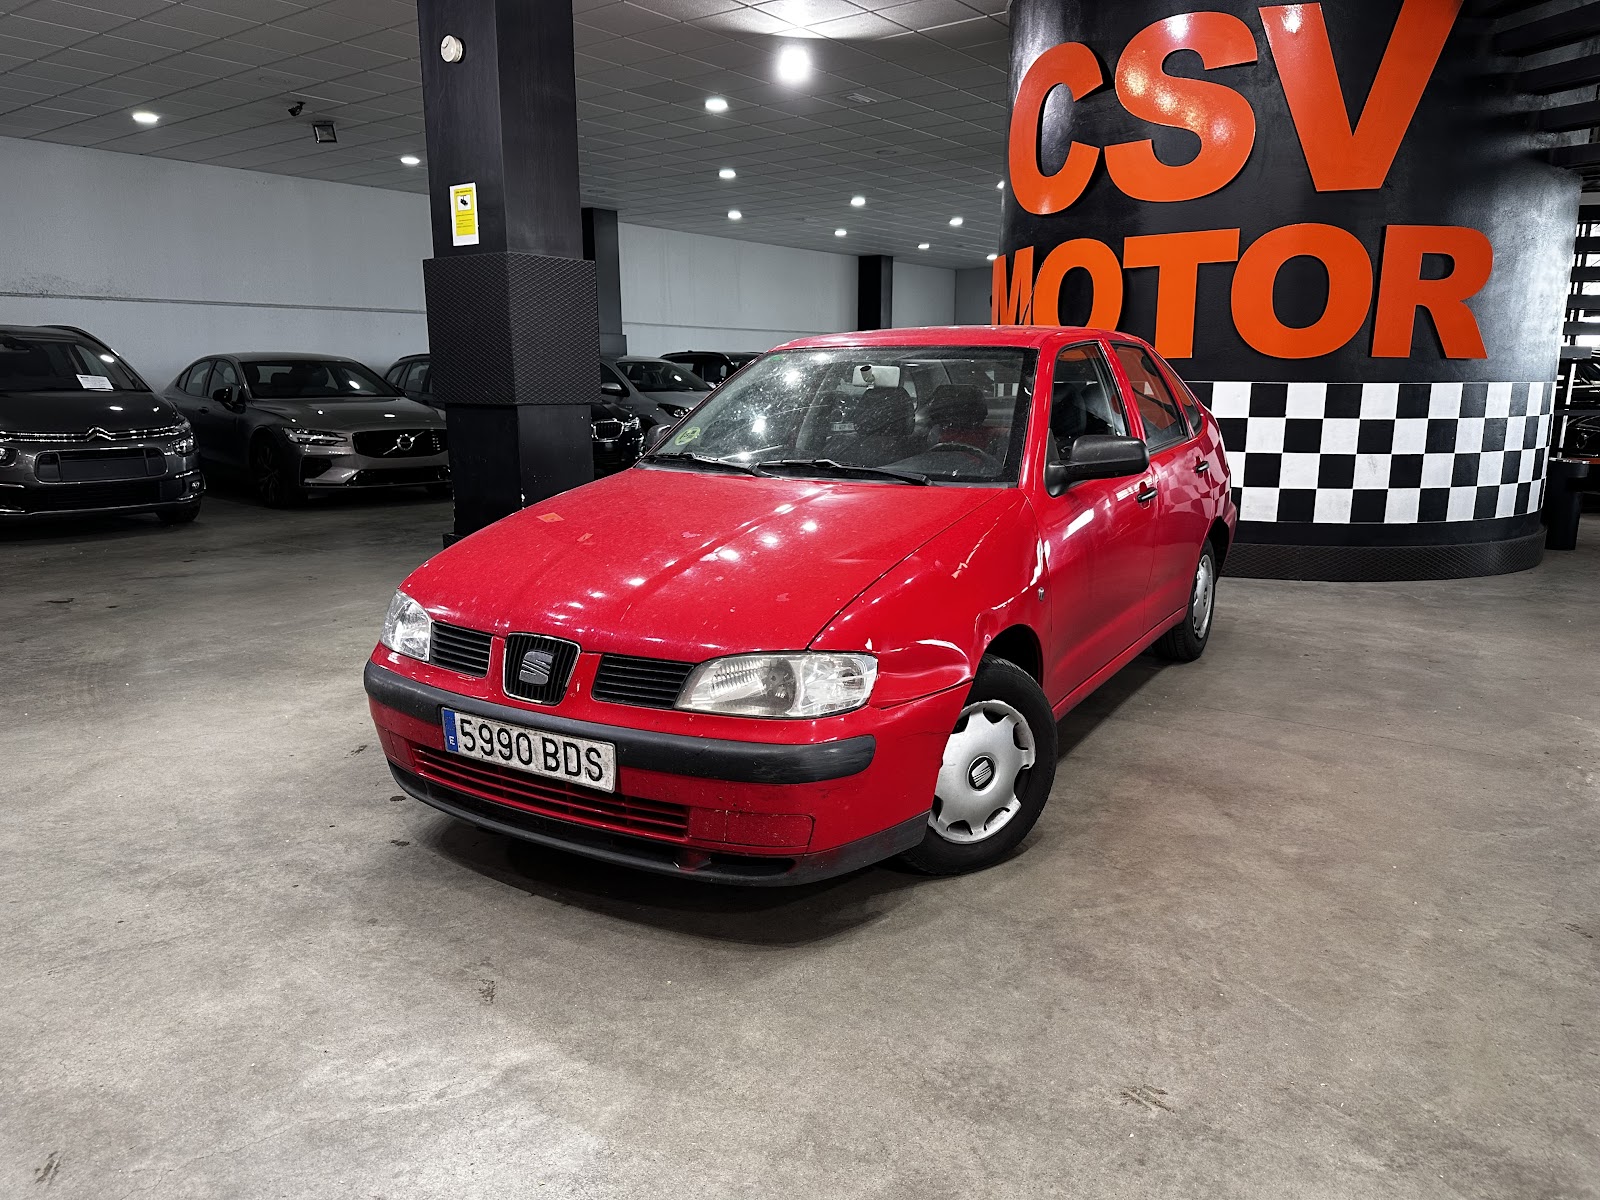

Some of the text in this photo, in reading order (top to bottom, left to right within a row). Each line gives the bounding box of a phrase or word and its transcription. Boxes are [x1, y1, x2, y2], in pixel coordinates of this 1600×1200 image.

[1009, 0, 1464, 215] CSV
[991, 223, 1494, 360] MOTOR
[448, 735, 456, 746] E
[460, 718, 604, 782] 5990 BDS
